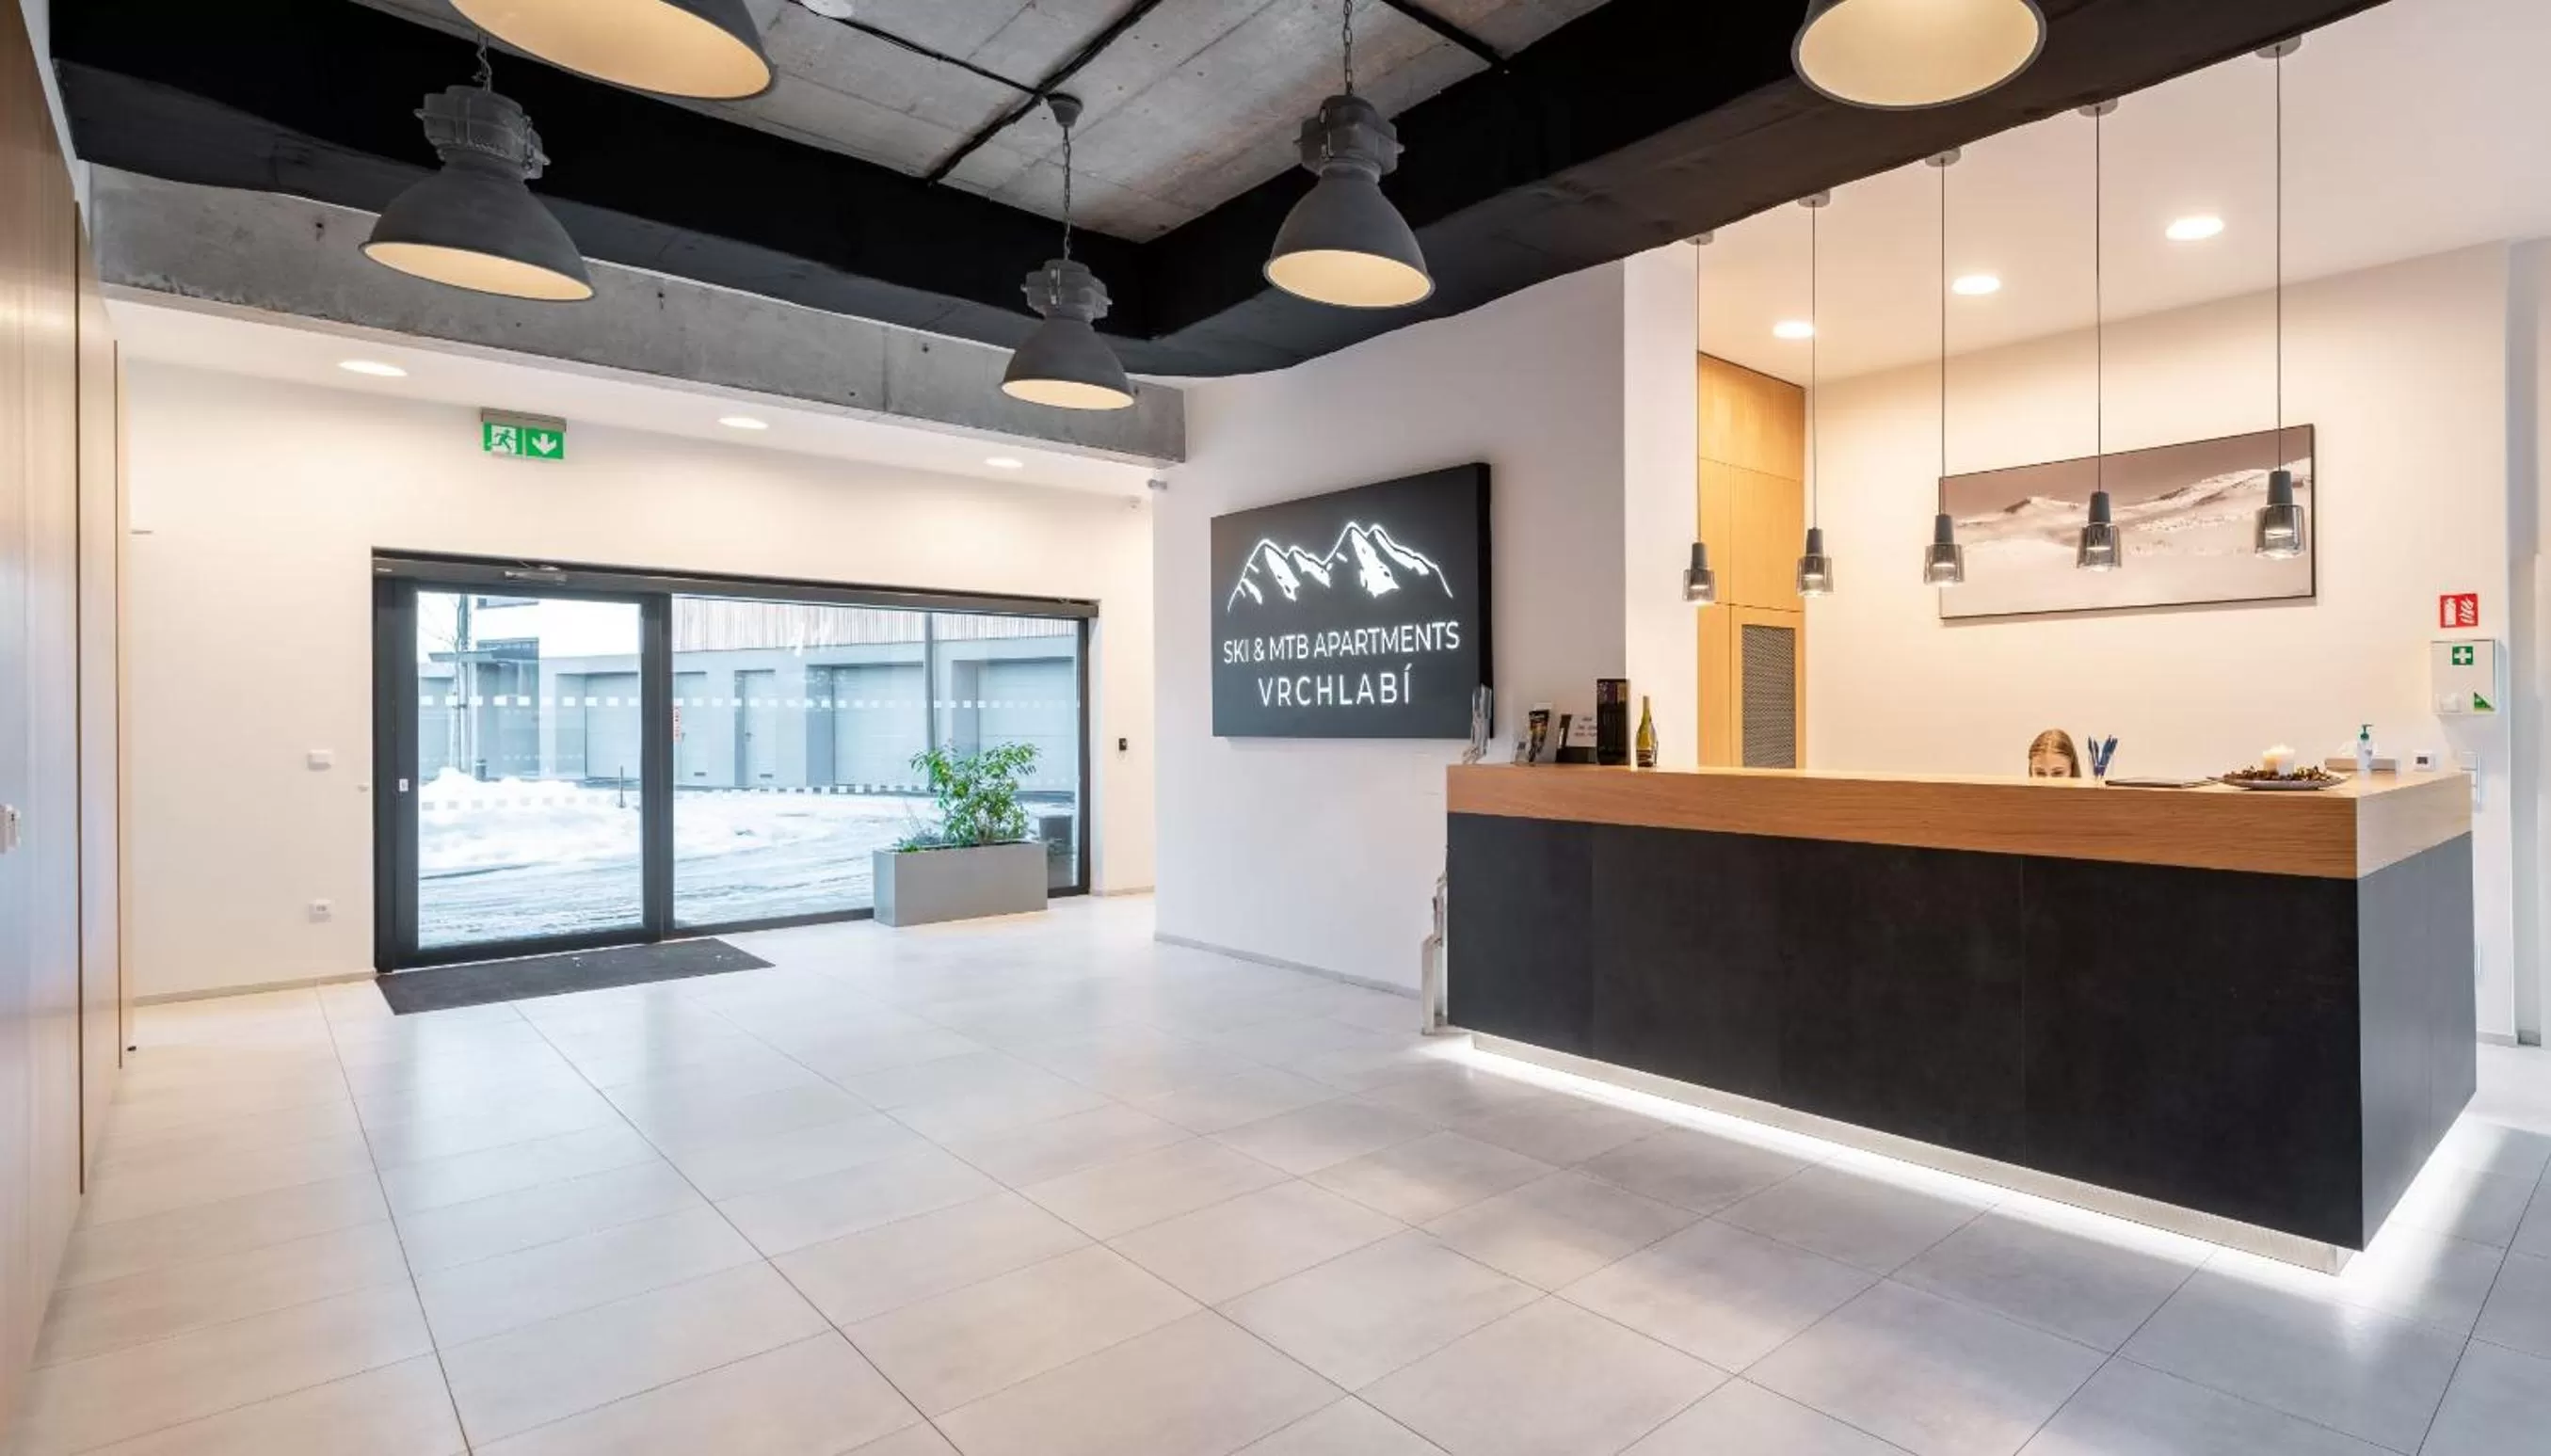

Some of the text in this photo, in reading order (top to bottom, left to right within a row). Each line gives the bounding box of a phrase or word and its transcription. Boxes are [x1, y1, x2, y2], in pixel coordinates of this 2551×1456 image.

[1224, 621, 1459, 664] SKI & MTB APARTMENTS
[1258, 664, 1411, 706] VRCHLABÍ
